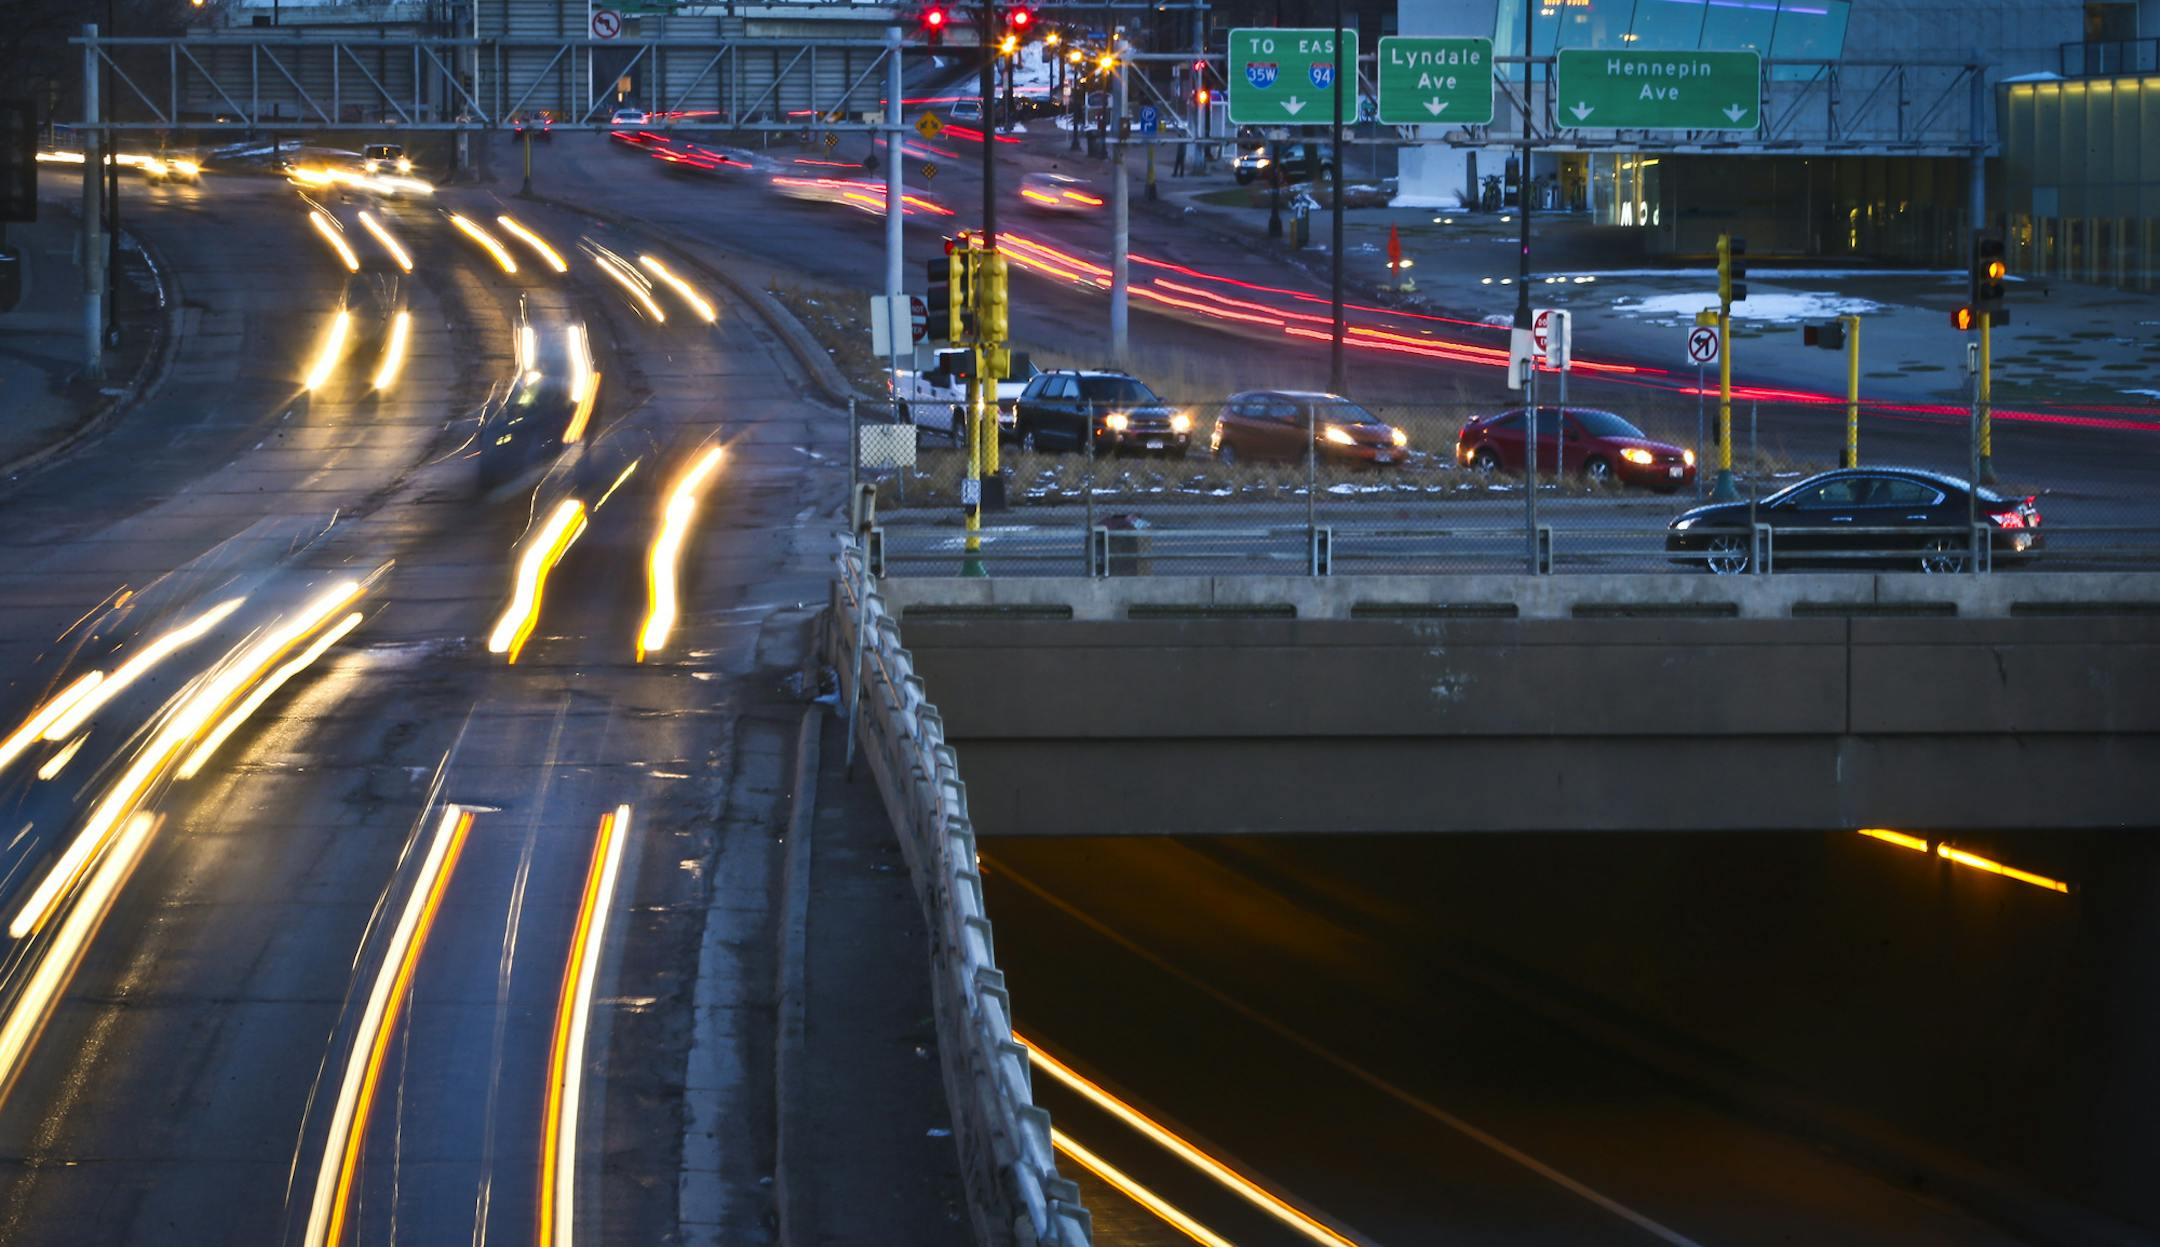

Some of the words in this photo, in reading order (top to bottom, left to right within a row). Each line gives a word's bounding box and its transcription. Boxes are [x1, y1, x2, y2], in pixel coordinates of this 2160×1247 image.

[1249, 38, 1275, 54] TO
[1299, 40, 1344, 53] EAS
[1391, 48, 1480, 69] Lyndale
[1248, 68, 1276, 81] 35W
[1313, 69, 1331, 84] 94
[1607, 58, 1711, 79] Hennepin
[1417, 72, 1457, 89] Ave
[1639, 83, 1679, 100] Ave
